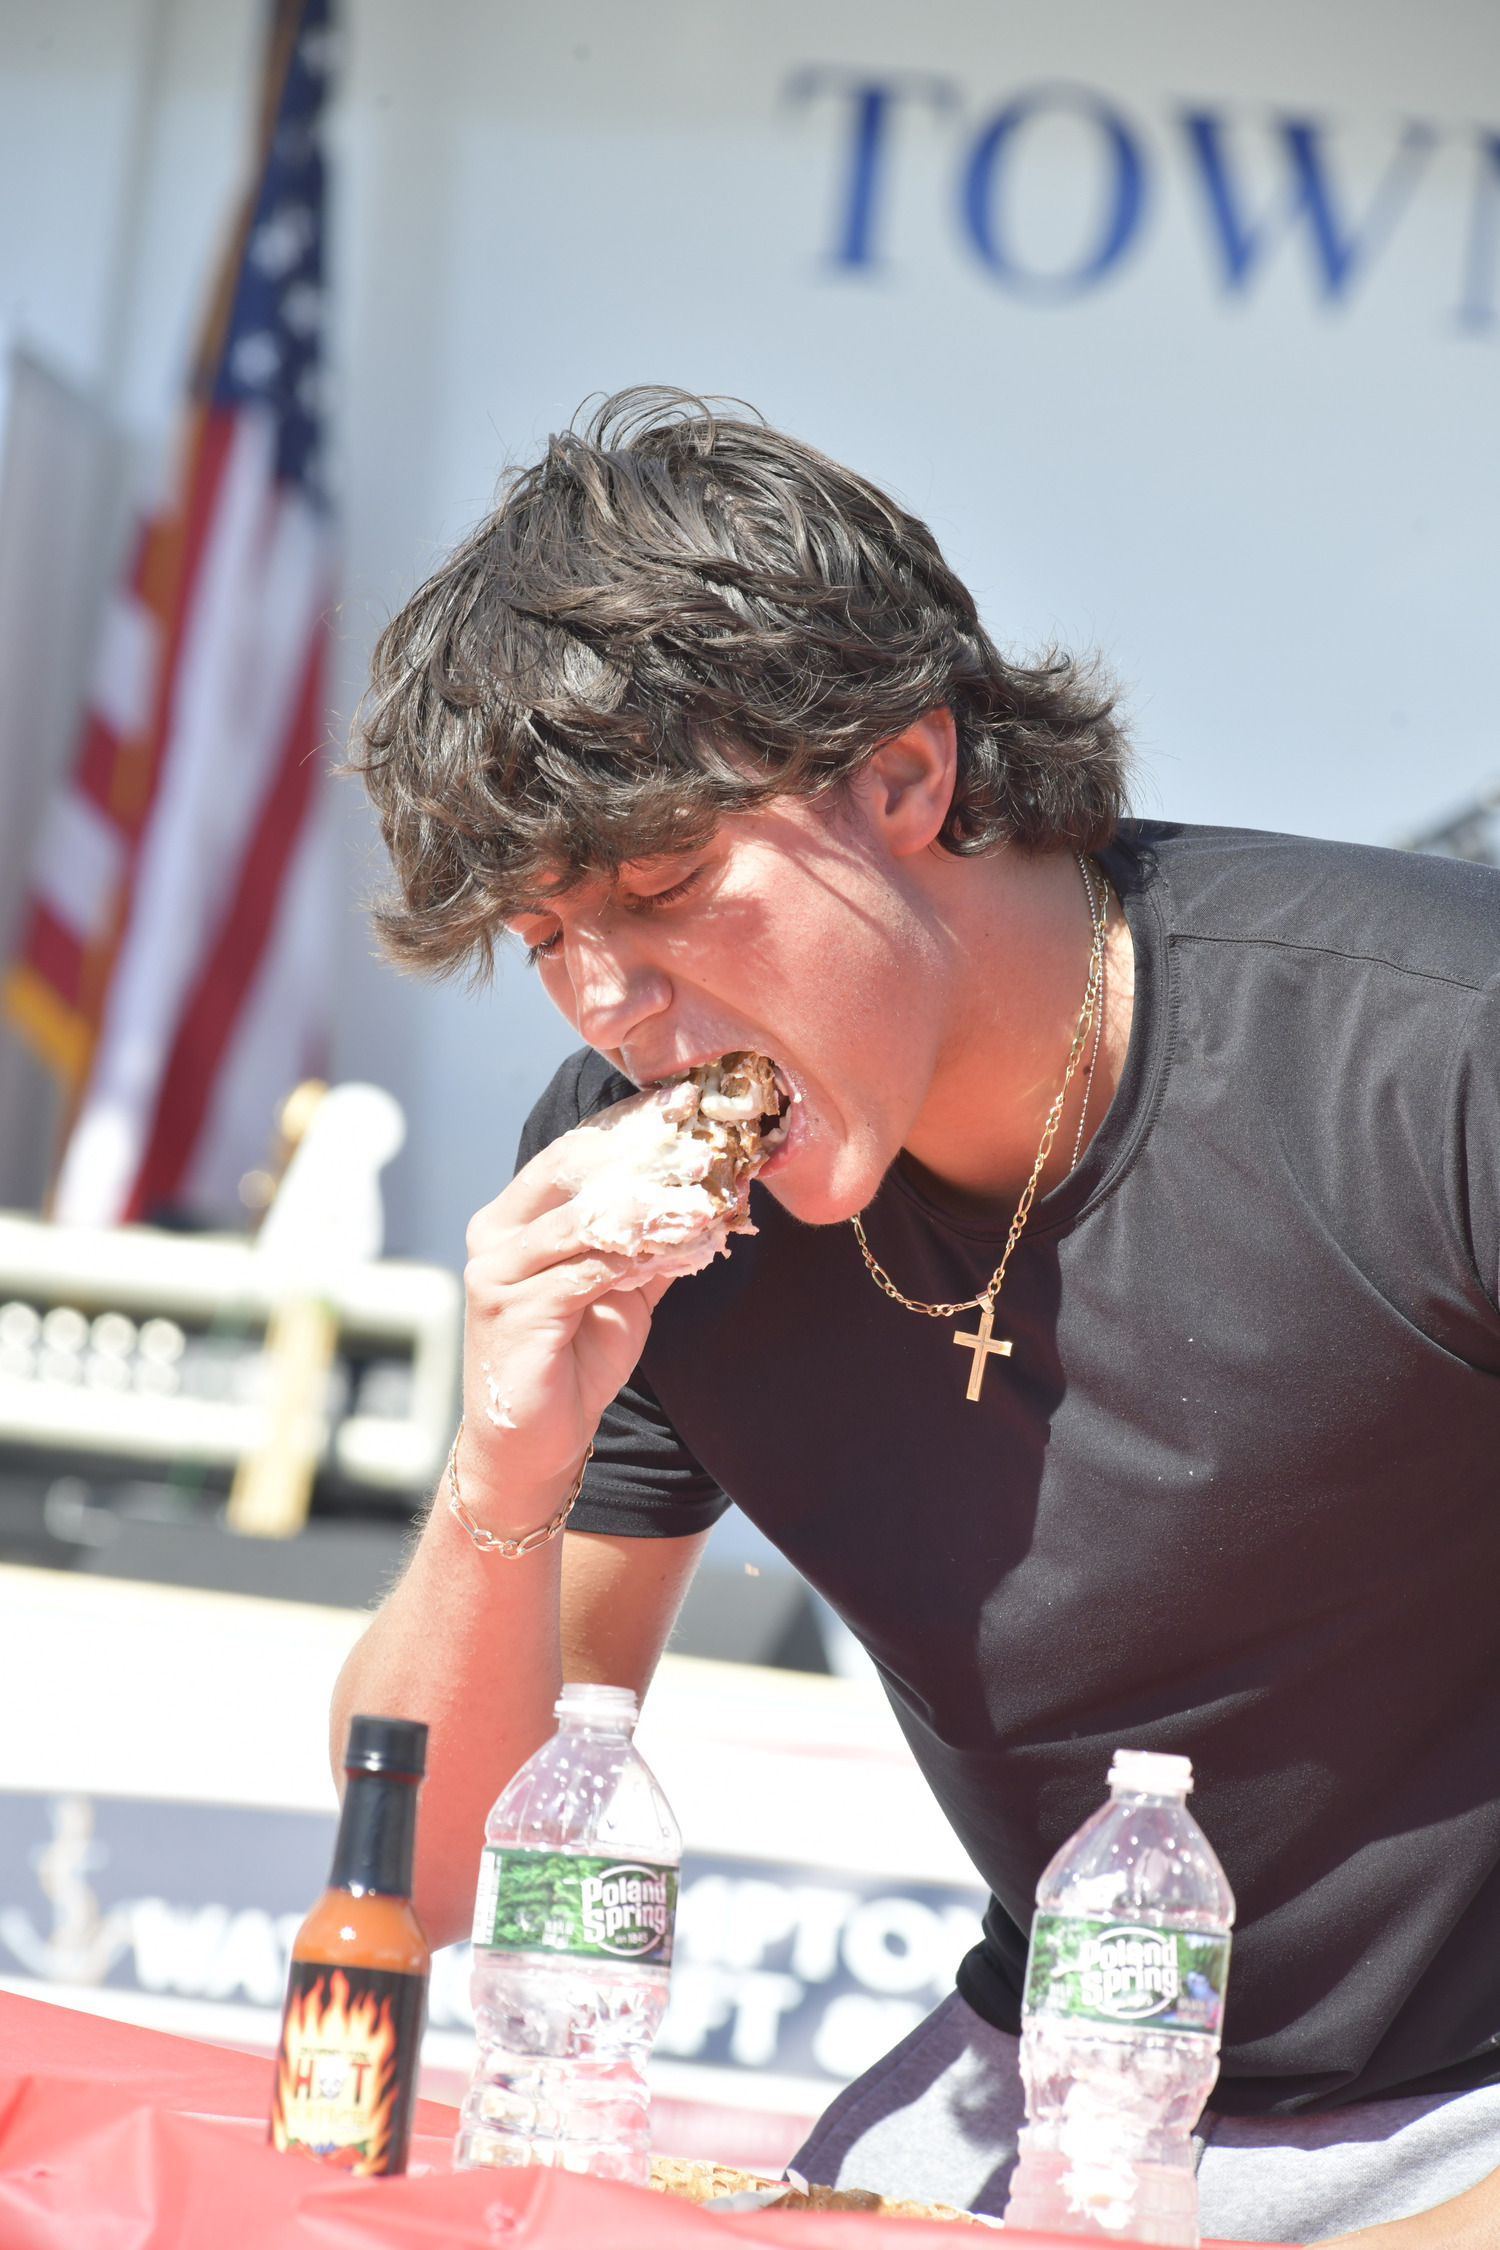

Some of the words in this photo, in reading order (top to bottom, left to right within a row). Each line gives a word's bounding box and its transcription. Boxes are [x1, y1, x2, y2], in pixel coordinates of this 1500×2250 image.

[580, 1871, 667, 1912] Poland
[582, 1904, 667, 1944] Spring
[1079, 1934, 1178, 1973] Poland
[1080, 1965, 1178, 2006] Spring
